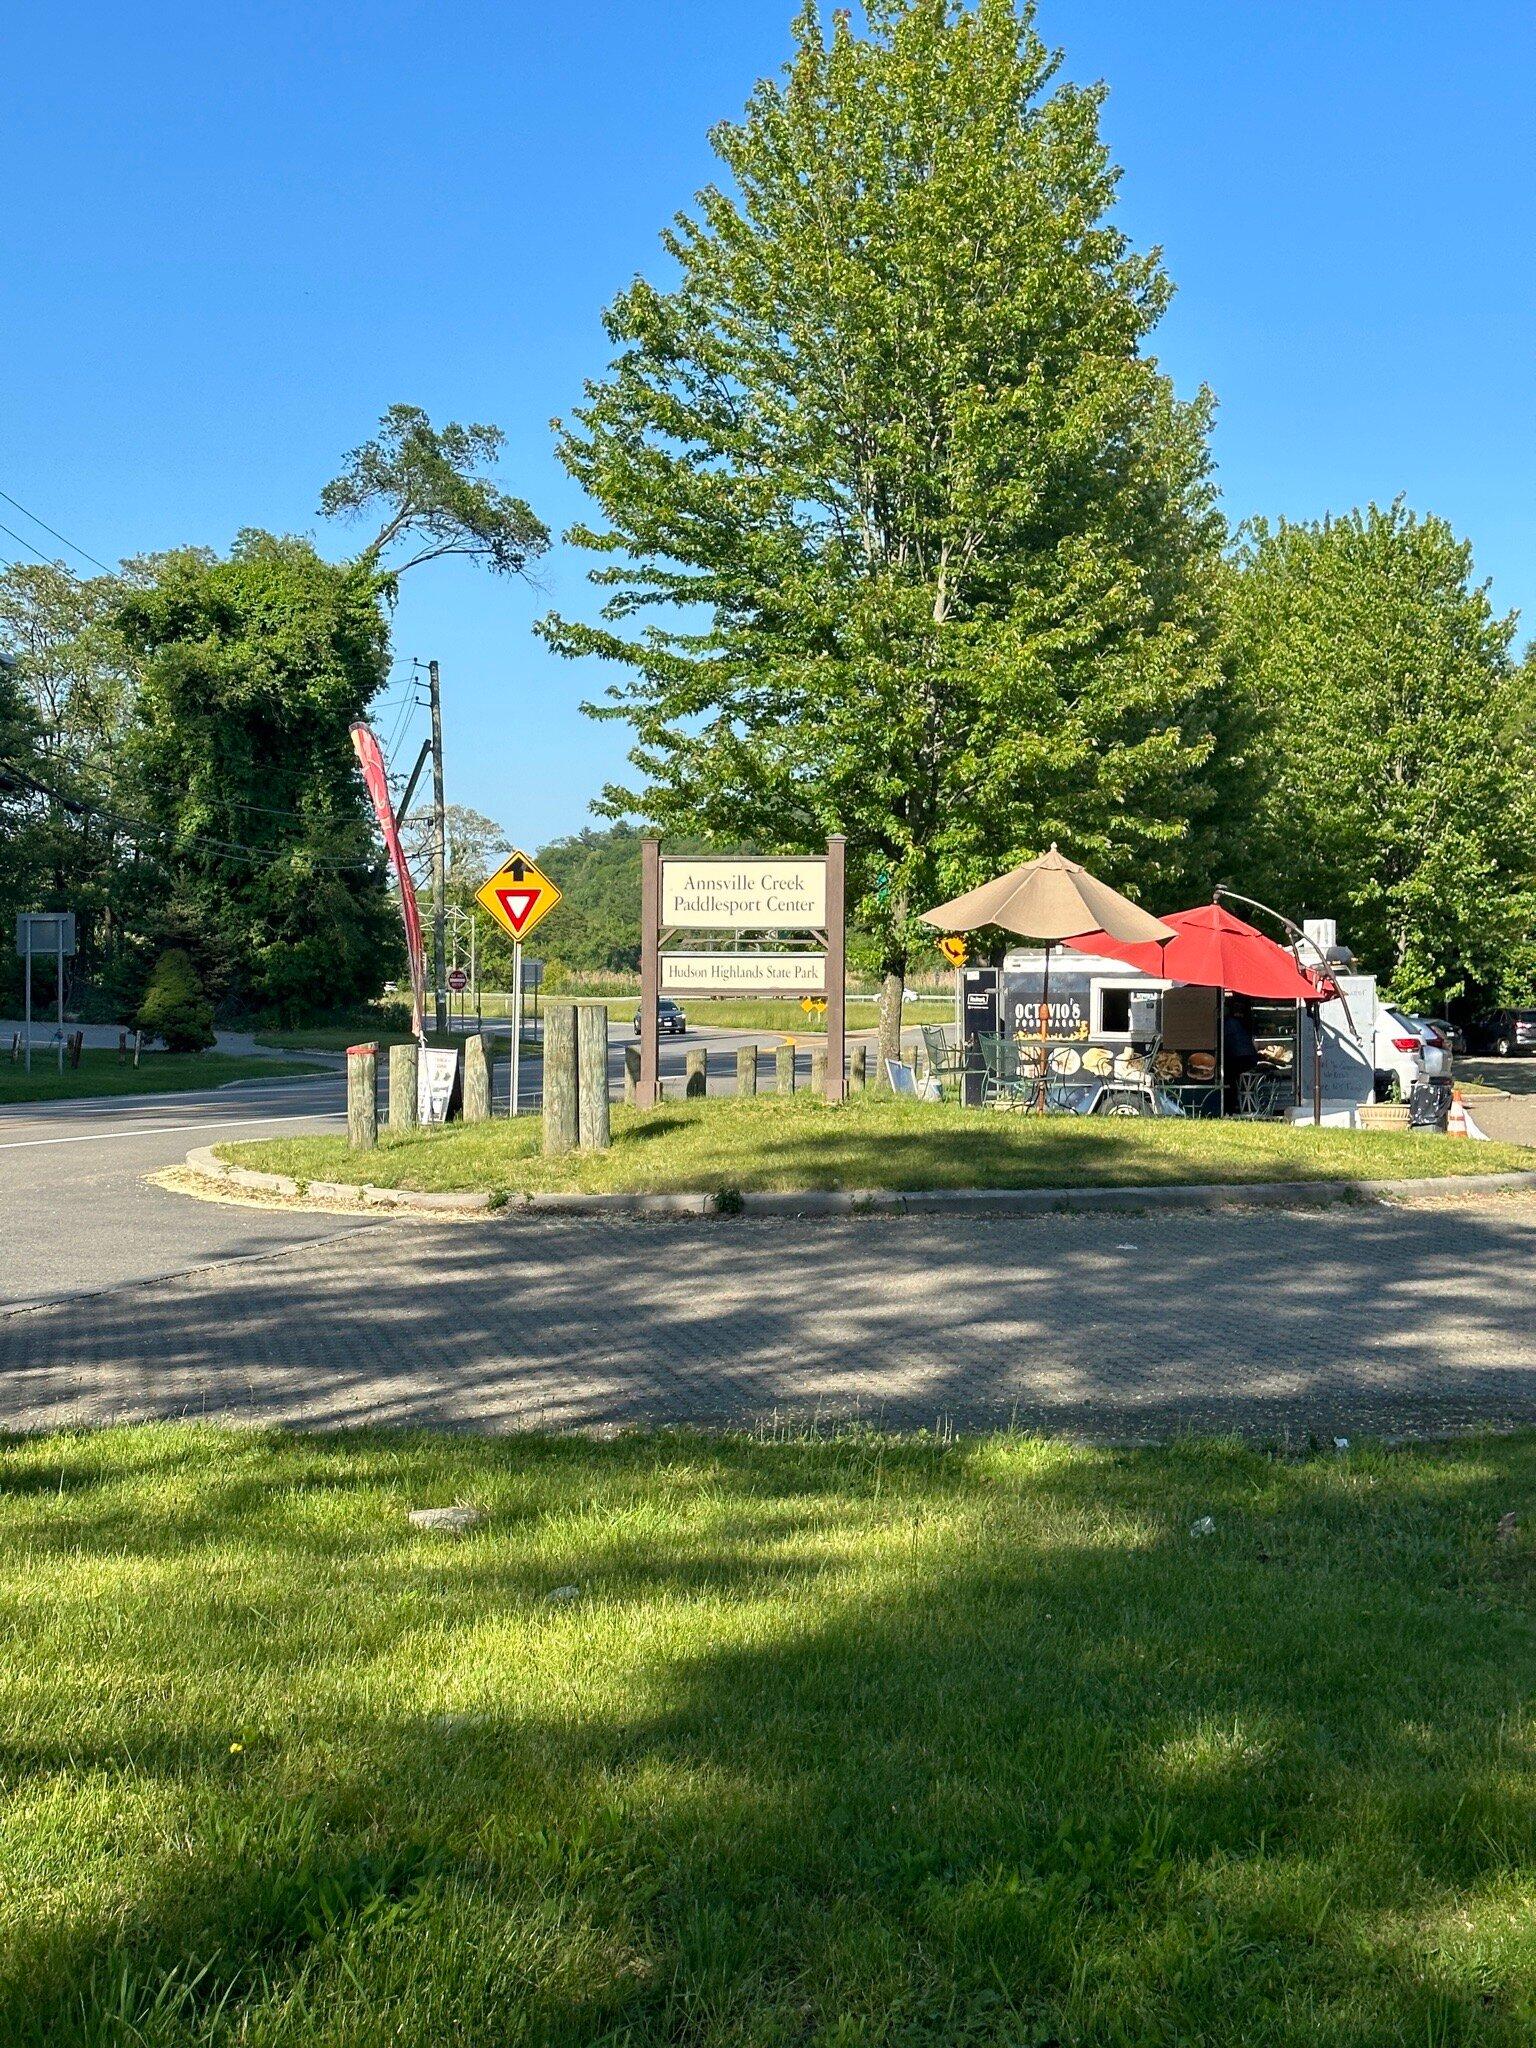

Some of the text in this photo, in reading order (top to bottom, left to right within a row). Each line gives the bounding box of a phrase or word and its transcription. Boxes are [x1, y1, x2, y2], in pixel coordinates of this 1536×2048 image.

[684, 874, 804, 890] Annsville Creek
[674, 895, 815, 915] Paddlesport Center
[669, 965, 818, 981] Hudson Highlands State Park
[1015, 998, 1081, 1019] OCTVIO'S
[1015, 1019, 1081, 1028] FOOD WAGON
